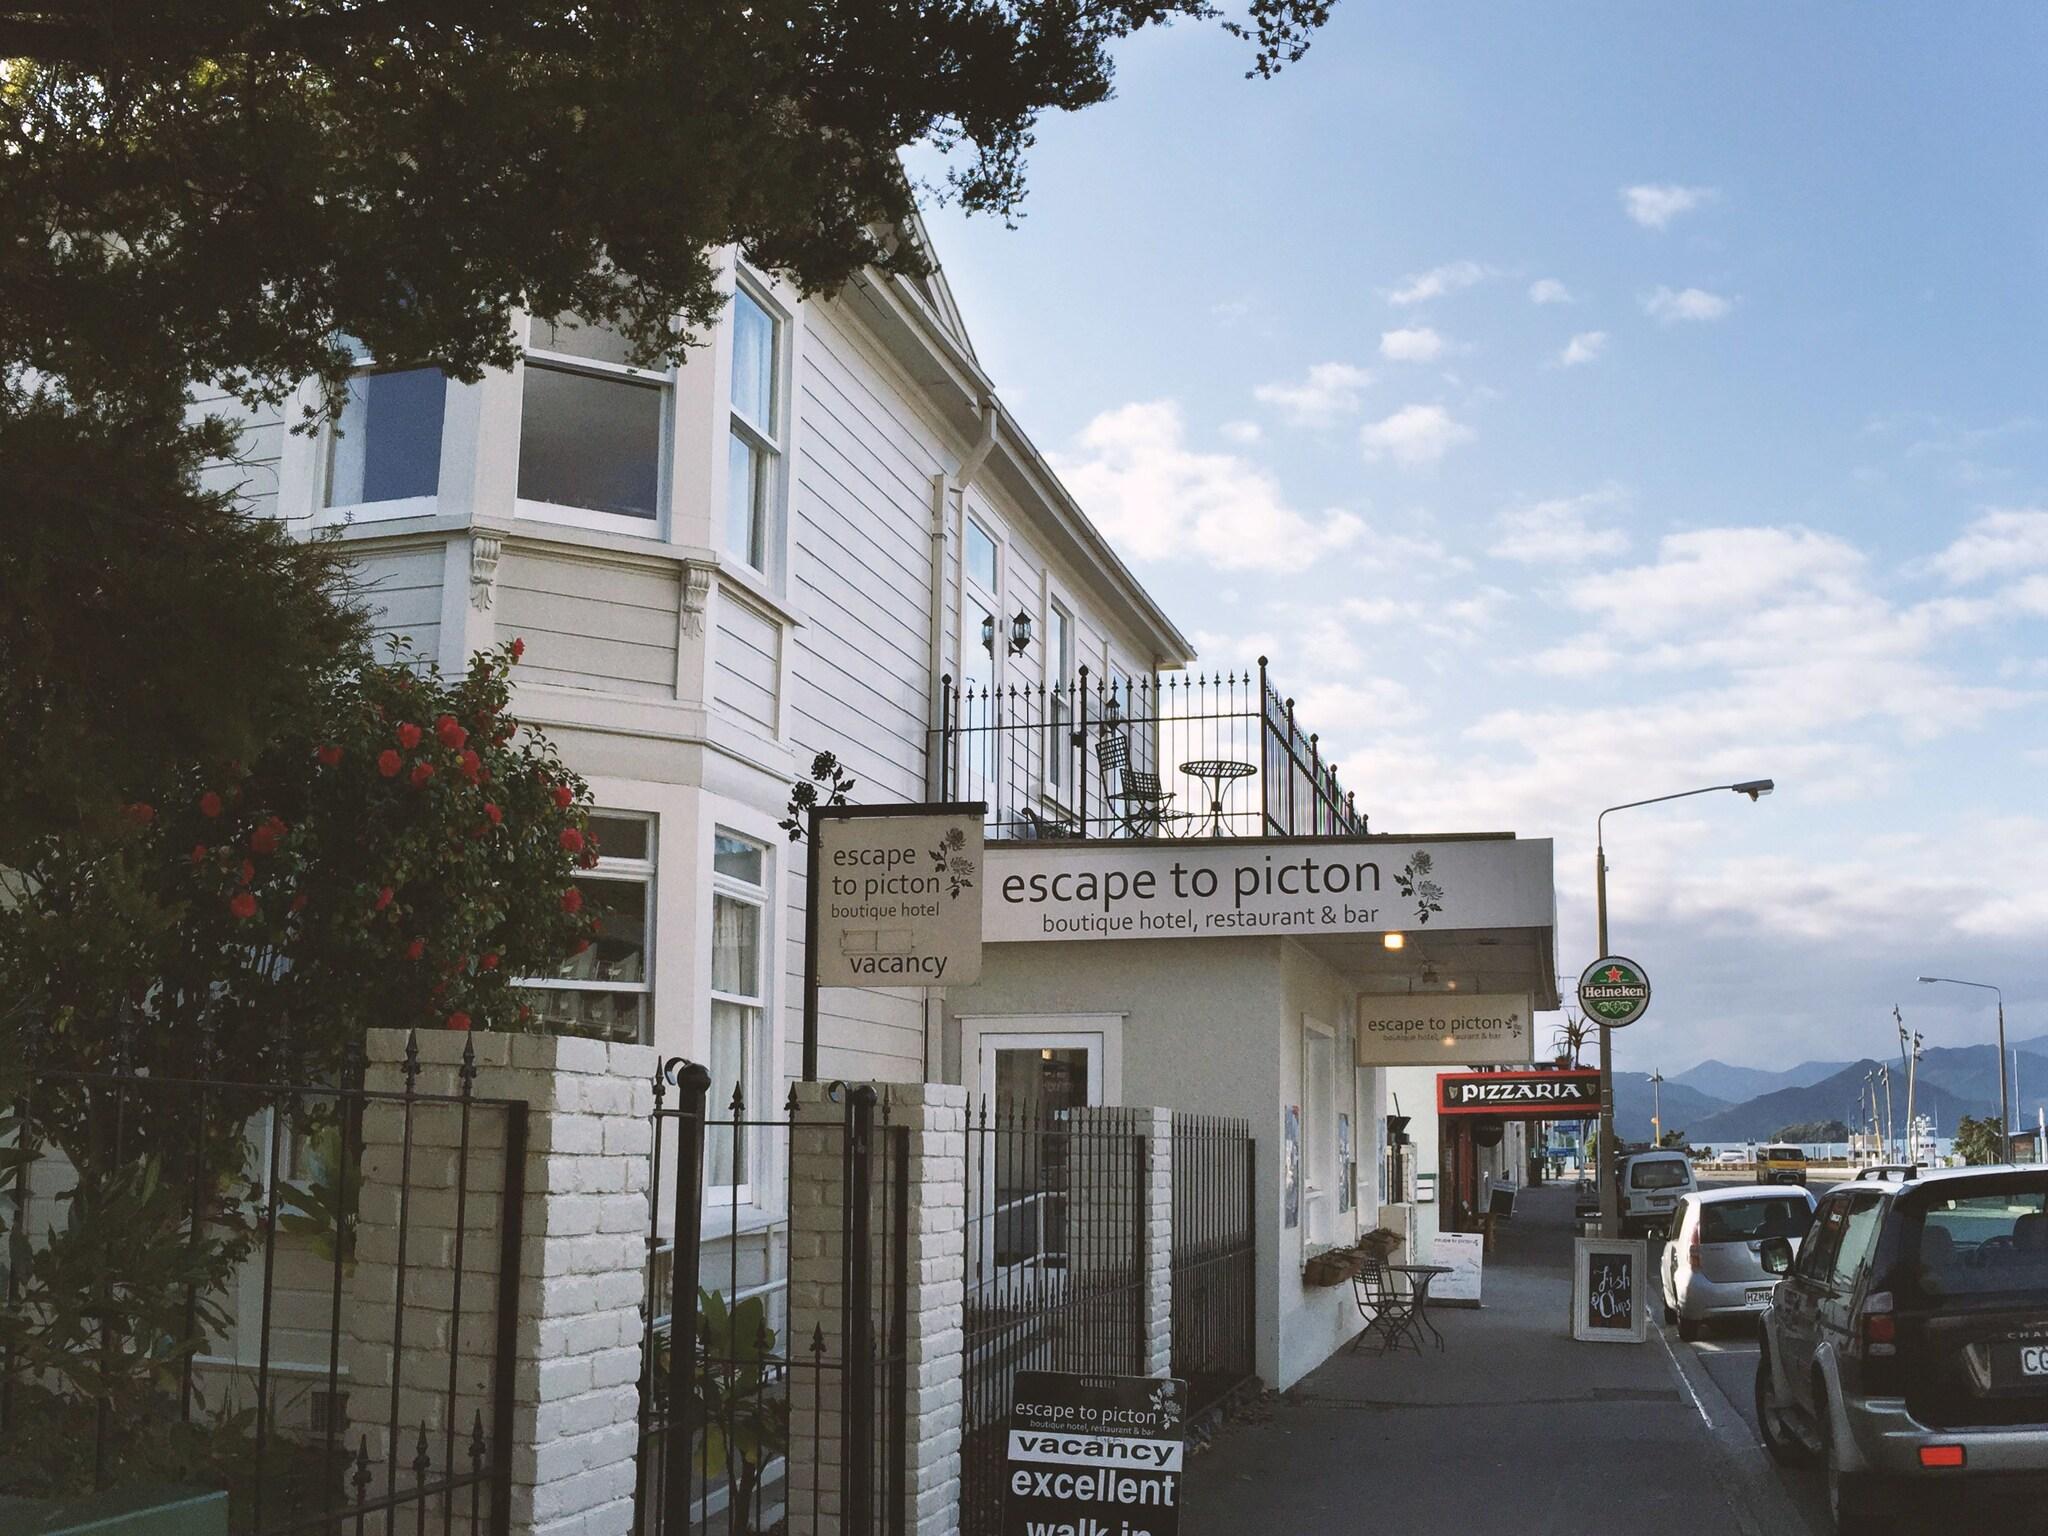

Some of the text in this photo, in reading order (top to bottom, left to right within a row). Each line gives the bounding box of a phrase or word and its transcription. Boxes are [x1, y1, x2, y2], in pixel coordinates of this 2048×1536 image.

[833, 848, 916, 871] escape
[832, 873, 940, 901] to picton
[1002, 856, 1381, 912] escape to picton
[831, 901, 940, 921] boutique hotel
[1043, 904, 1379, 936] boutique hotel, restaurant & bar
[850, 956, 948, 978] vacancy
[1585, 985, 1645, 997] Heineken
[1368, 1016, 1502, 1034] escape to picton
[1462, 1082, 1582, 1103] PIZZARIA
[1015, 1402, 1156, 1426] escape to picton
[1030, 1420, 1065, 1430] boutique
[1091, 1425, 1132, 1435] restaurant
[1141, 1428, 1156, 1436] bar
[1017, 1436, 1175, 1467] vacancy
[1011, 1468, 1176, 1507] excellent
